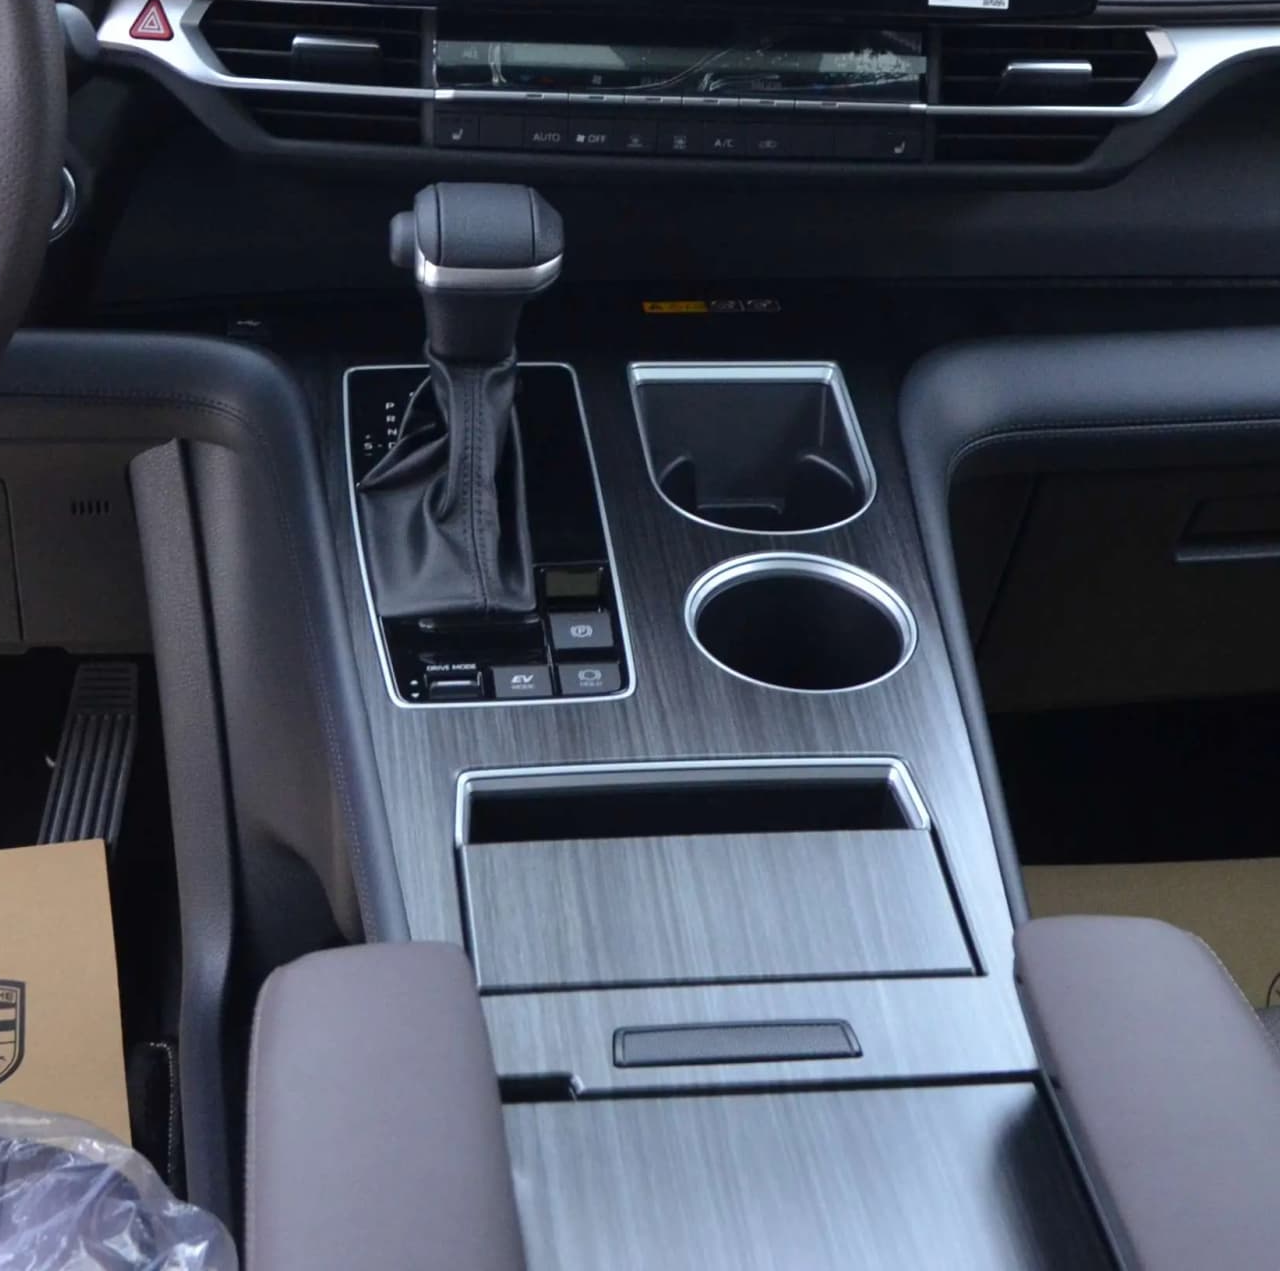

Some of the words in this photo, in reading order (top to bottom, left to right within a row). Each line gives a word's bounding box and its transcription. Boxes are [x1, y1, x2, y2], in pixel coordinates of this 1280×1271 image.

[532, 131, 561, 143] AUTO
[587, 133, 607, 145] OFF
[713, 137, 735, 149] A/C
[426, 664, 450, 672] DRIVE
[451, 663, 477, 671] MODE
[511, 674, 535, 684] EV
